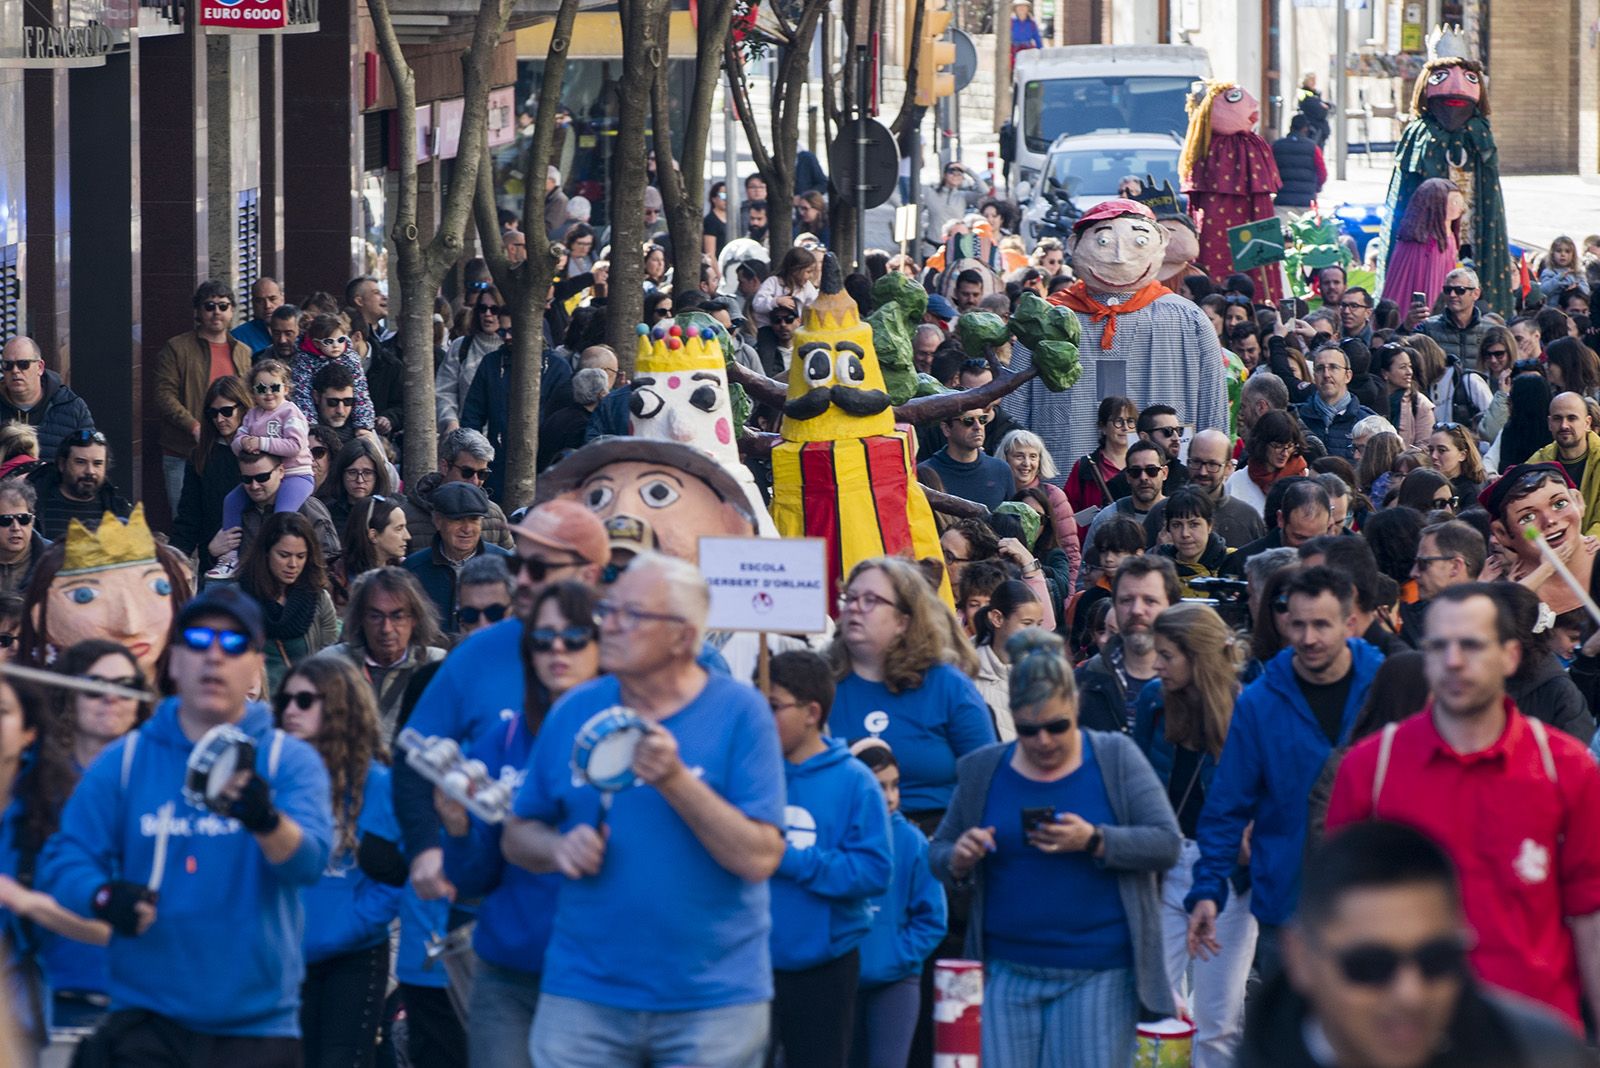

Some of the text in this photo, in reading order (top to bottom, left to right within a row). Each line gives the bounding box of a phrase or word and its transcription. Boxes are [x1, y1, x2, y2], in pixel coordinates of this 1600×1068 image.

[204, 7, 240, 19] EURO
[243, 8, 281, 20] 6000
[740, 563, 786, 572] ESCOLA
